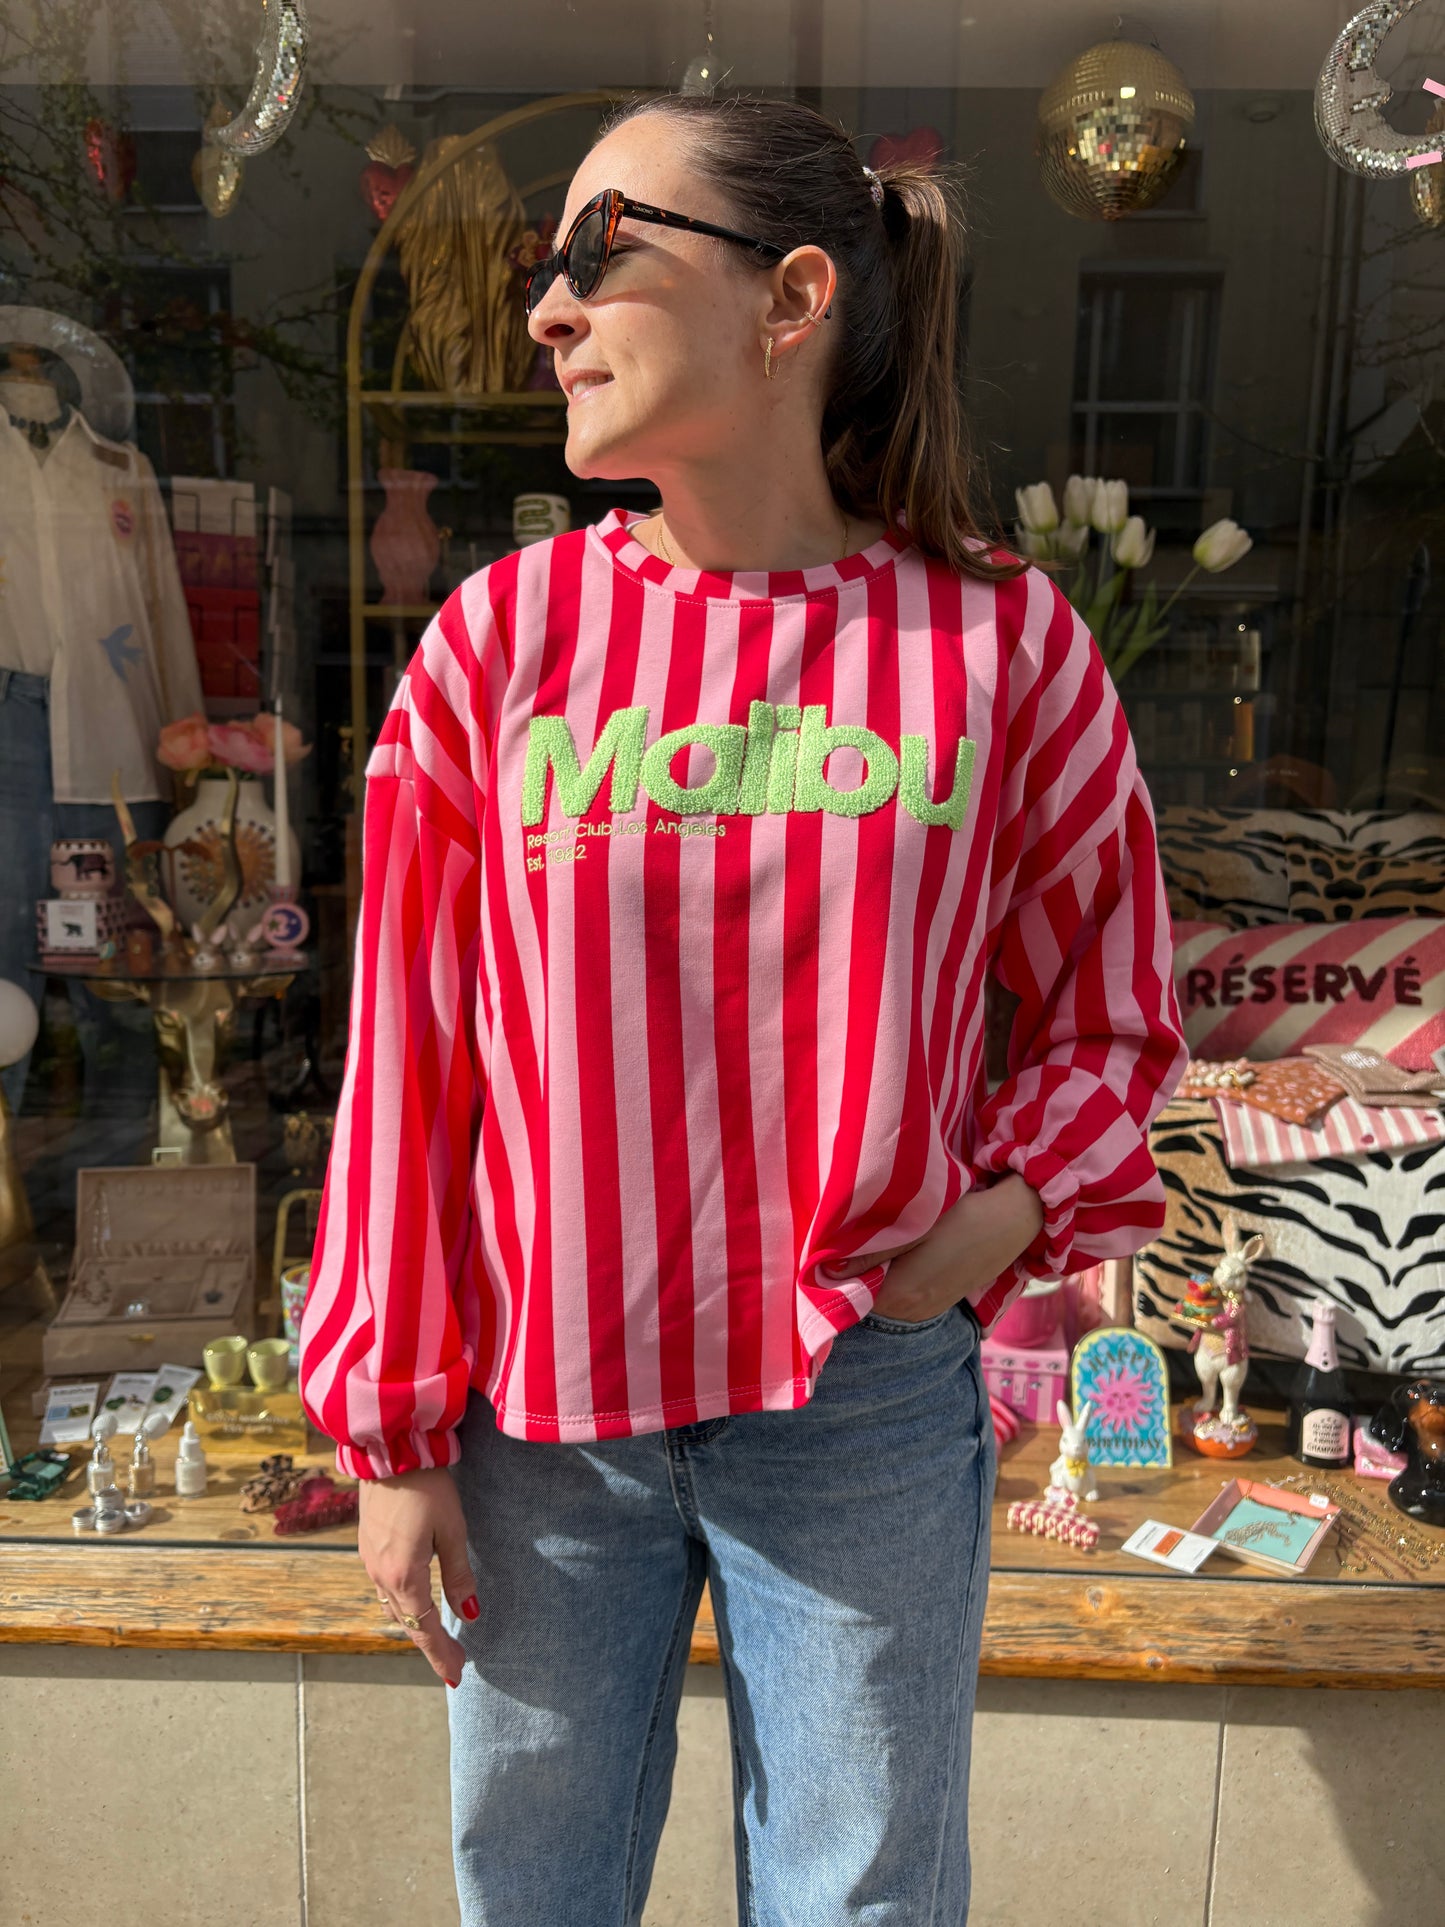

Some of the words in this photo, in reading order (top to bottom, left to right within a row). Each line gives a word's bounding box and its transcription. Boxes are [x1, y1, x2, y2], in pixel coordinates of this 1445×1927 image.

[521, 700, 976, 830] Malibu
[527, 828, 570, 849] Resort
[619, 821, 648, 835] Los
[653, 819, 726, 838] Angeles
[547, 844, 587, 864] 1982
[1187, 953, 1423, 1008] RÉSERVÉ
[1088, 1348, 1154, 1372] HAPPY
[1086, 1436, 1160, 1450] BIRTHDAY
